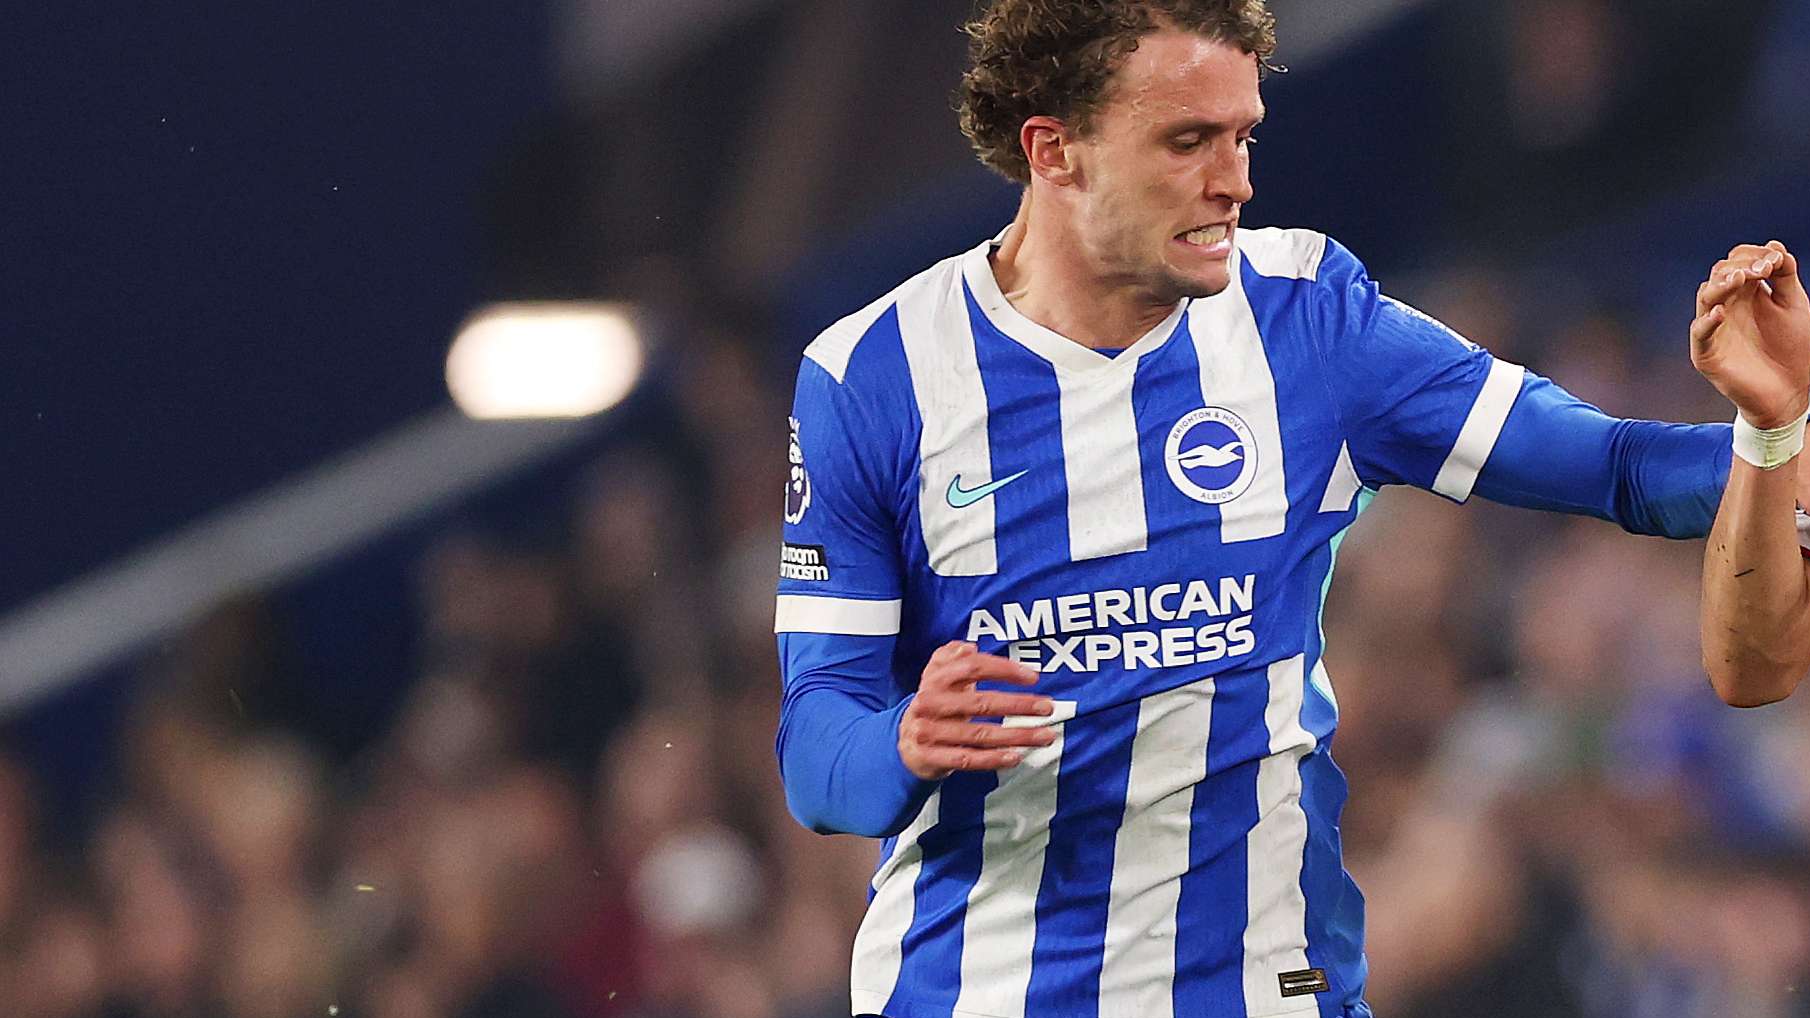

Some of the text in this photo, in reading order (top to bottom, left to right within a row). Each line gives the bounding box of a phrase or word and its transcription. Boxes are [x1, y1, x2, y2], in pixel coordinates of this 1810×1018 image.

[1172, 411, 1211, 439] BRIGHTON
[1223, 414, 1244, 433] HOVE
[1200, 489, 1234, 500] ALBION
[967, 574, 1255, 642] AMERICAN
[1008, 614, 1255, 673] EXPRESS
